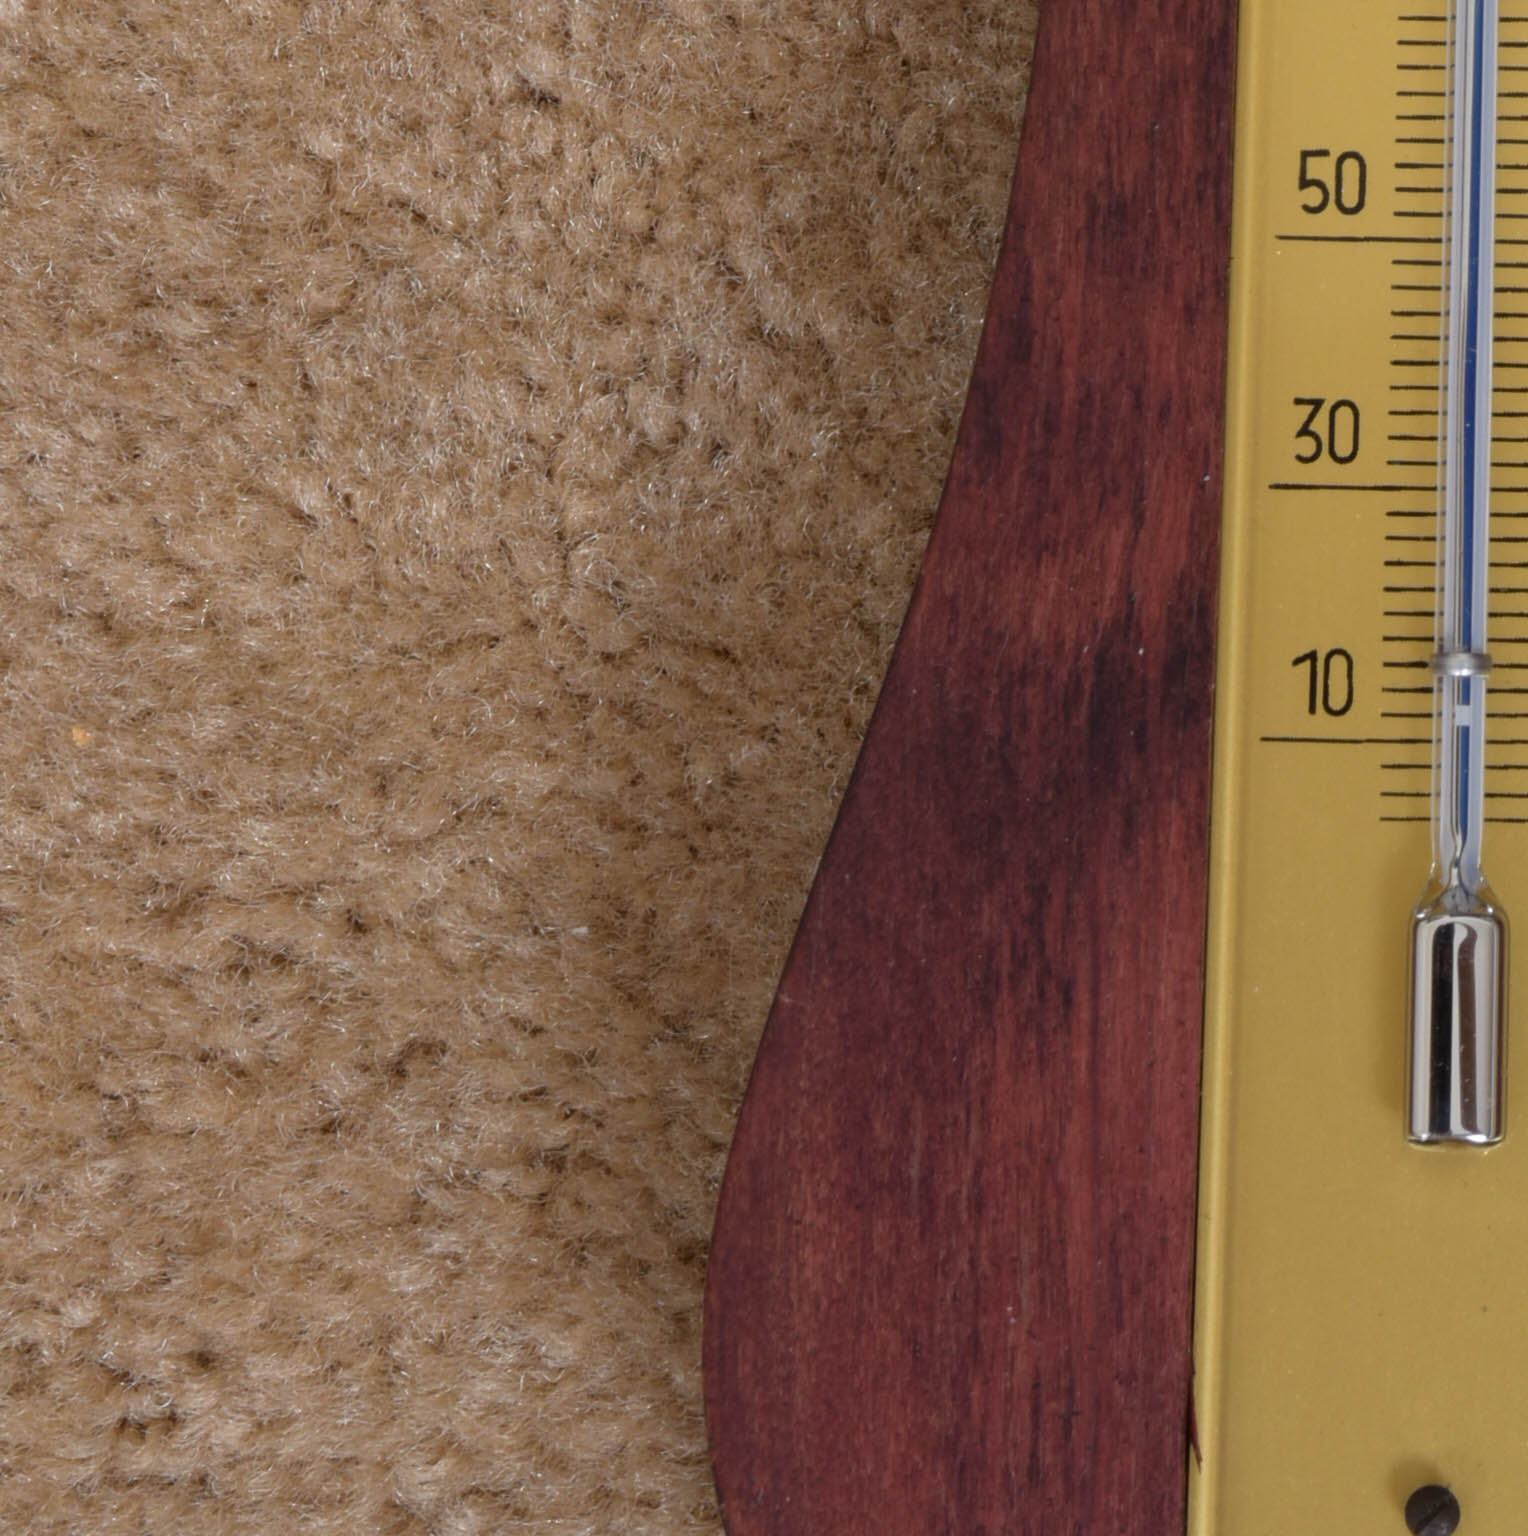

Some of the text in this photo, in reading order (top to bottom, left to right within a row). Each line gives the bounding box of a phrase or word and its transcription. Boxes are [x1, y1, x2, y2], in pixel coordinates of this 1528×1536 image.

[1299, 149, 1366, 215] 50
[1294, 398, 1360, 464] 30
[1292, 648, 1353, 717] 10
